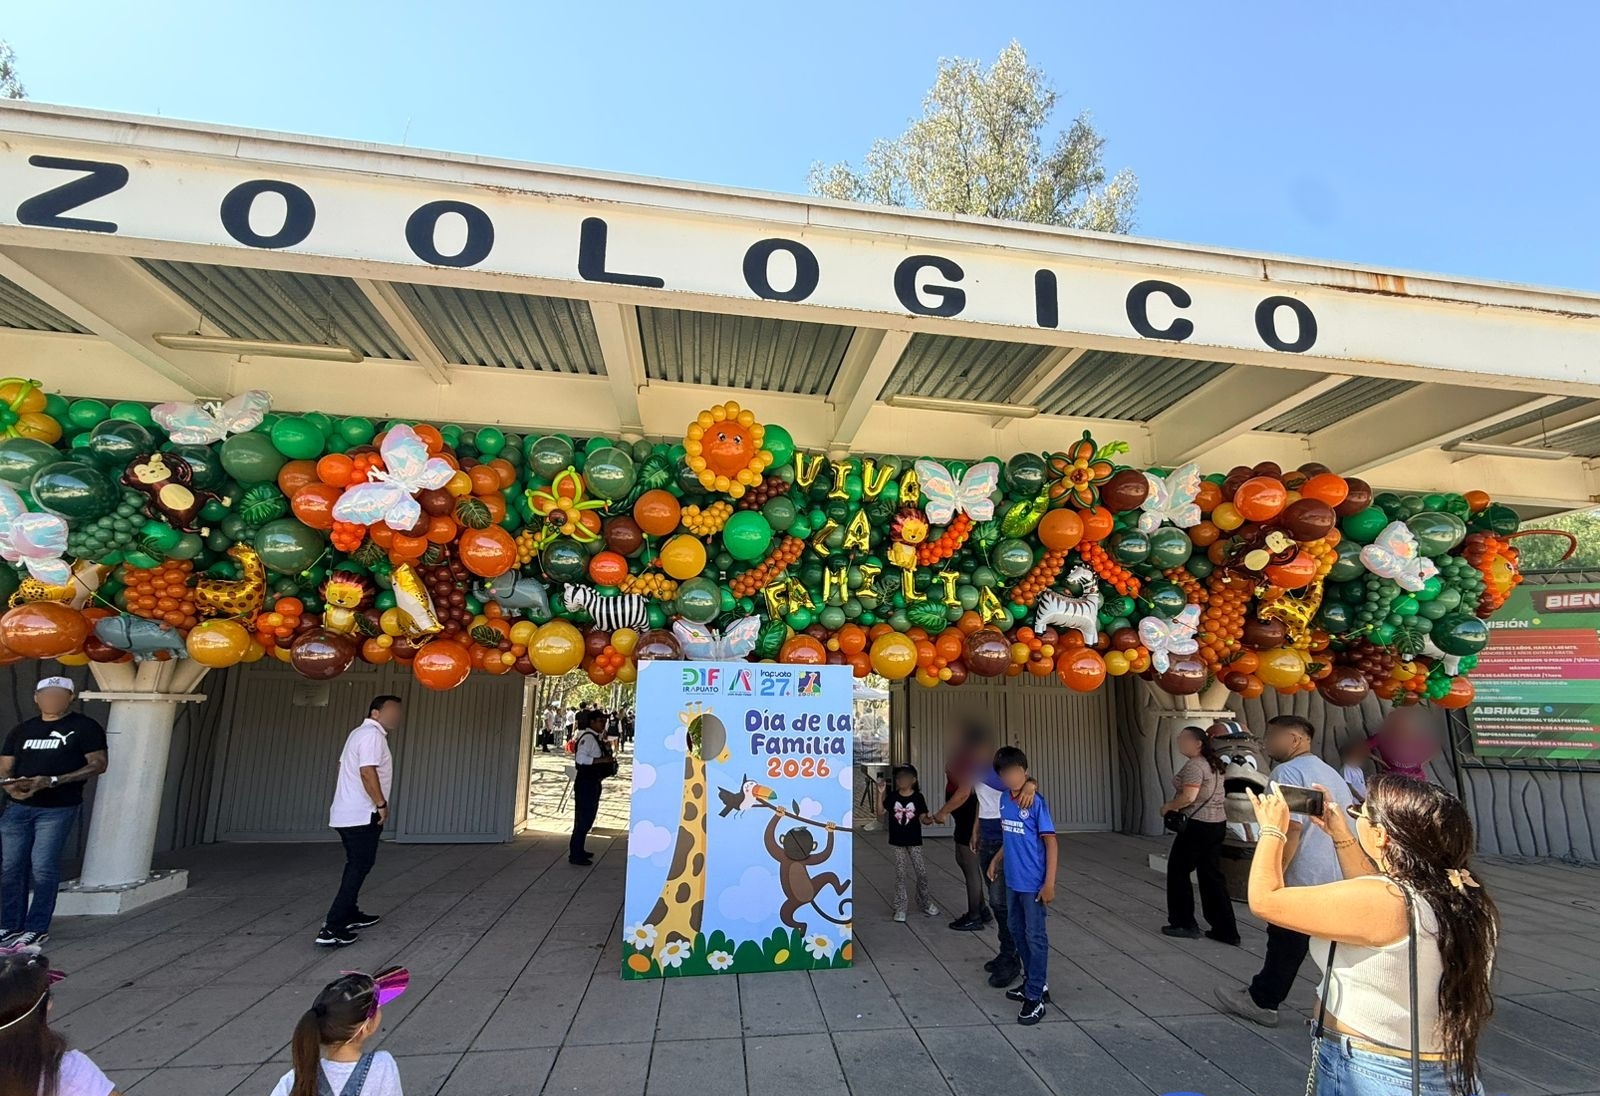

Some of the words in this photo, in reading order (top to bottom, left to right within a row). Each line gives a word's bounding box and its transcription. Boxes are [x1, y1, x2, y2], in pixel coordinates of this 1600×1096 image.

[17, 155, 1318, 353] ZOOLOGICO
[794, 451, 921, 508] VIVA
[812, 507, 871, 557] LA
[764, 564, 1007, 624] FAMILIA
[682, 668, 720, 686] DIF
[760, 669, 792, 678] Irapuato
[745, 709, 786, 732] Día
[792, 712, 821, 732] de
[827, 713, 852, 732] la
[1472, 706, 1540, 715] ABRIMOS
[23, 739, 61, 750] PUMA
[751, 733, 846, 755] Familia
[767, 757, 830, 778] 2026
